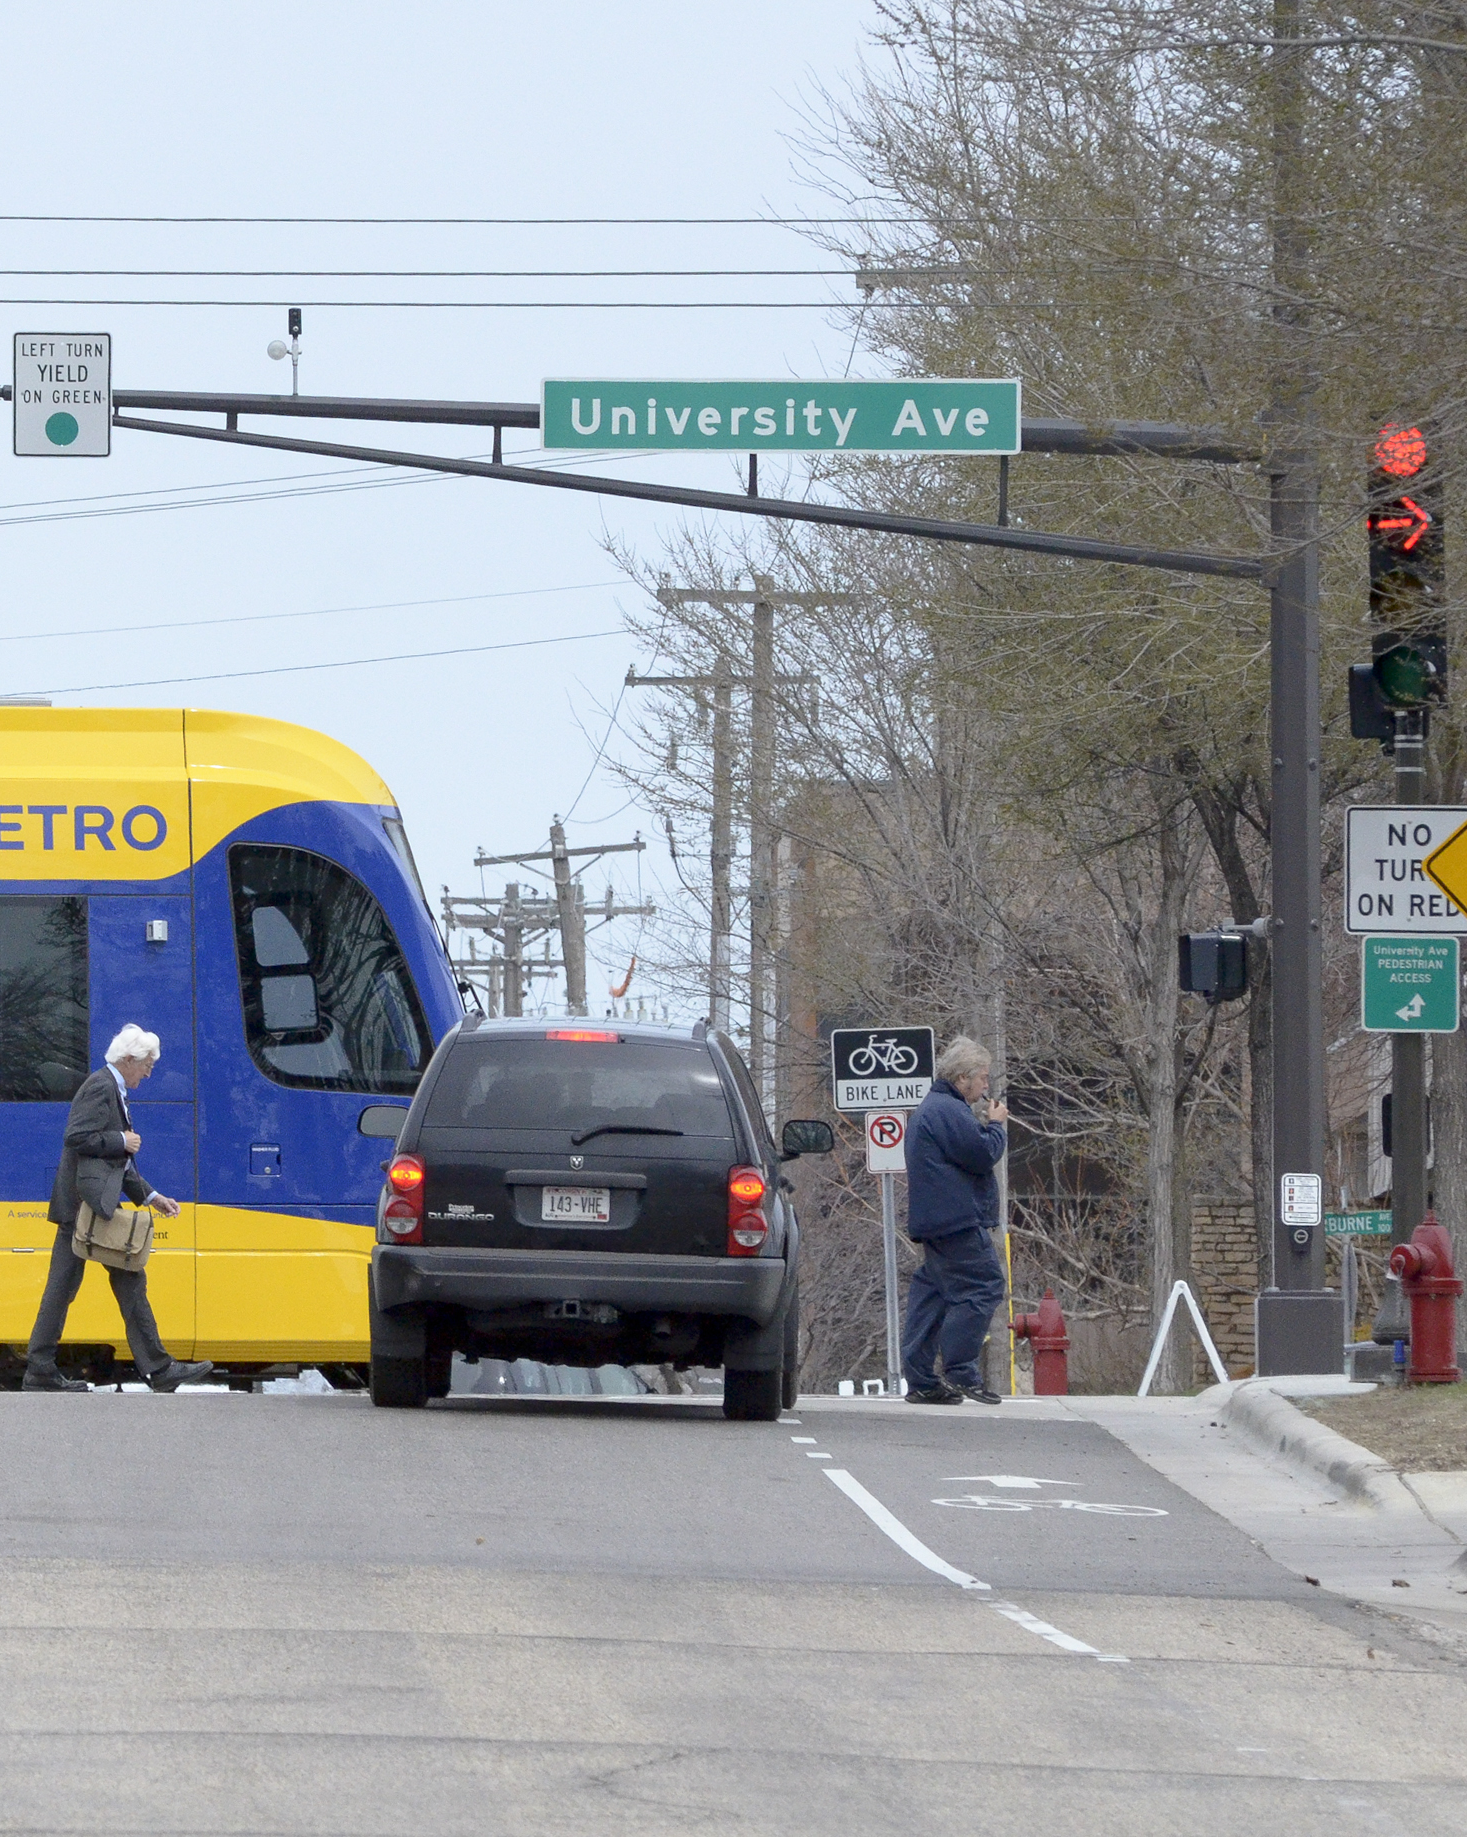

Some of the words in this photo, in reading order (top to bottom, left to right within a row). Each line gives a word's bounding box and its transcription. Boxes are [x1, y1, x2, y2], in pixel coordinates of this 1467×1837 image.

[21, 342, 56, 357] LEFT
[65, 343, 104, 358] TURN
[36, 363, 89, 383] YIELD
[23, 389, 43, 404] ON
[51, 390, 102, 405] GREEN
[570, 397, 858, 446] University
[891, 398, 991, 437] Ave
[1388, 823, 1433, 847] NO
[1374, 858, 1432, 882] TUR
[1358, 893, 1394, 917] ON
[1373, 945, 1425, 958] University
[1428, 946, 1449, 956] Ave
[1377, 958, 1444, 970] PEDESTRIAN
[1389, 972, 1433, 984] ACCESS
[846, 1085, 879, 1102] BIKE
[886, 1083, 924, 1100] LANE
[7, 1209, 15, 1218] A
[17, 1208, 48, 1219] service
[549, 1196, 604, 1214] 143-VHE
[428, 1211, 495, 1221] DURANGO
[1325, 1215, 1374, 1232] BURNE
